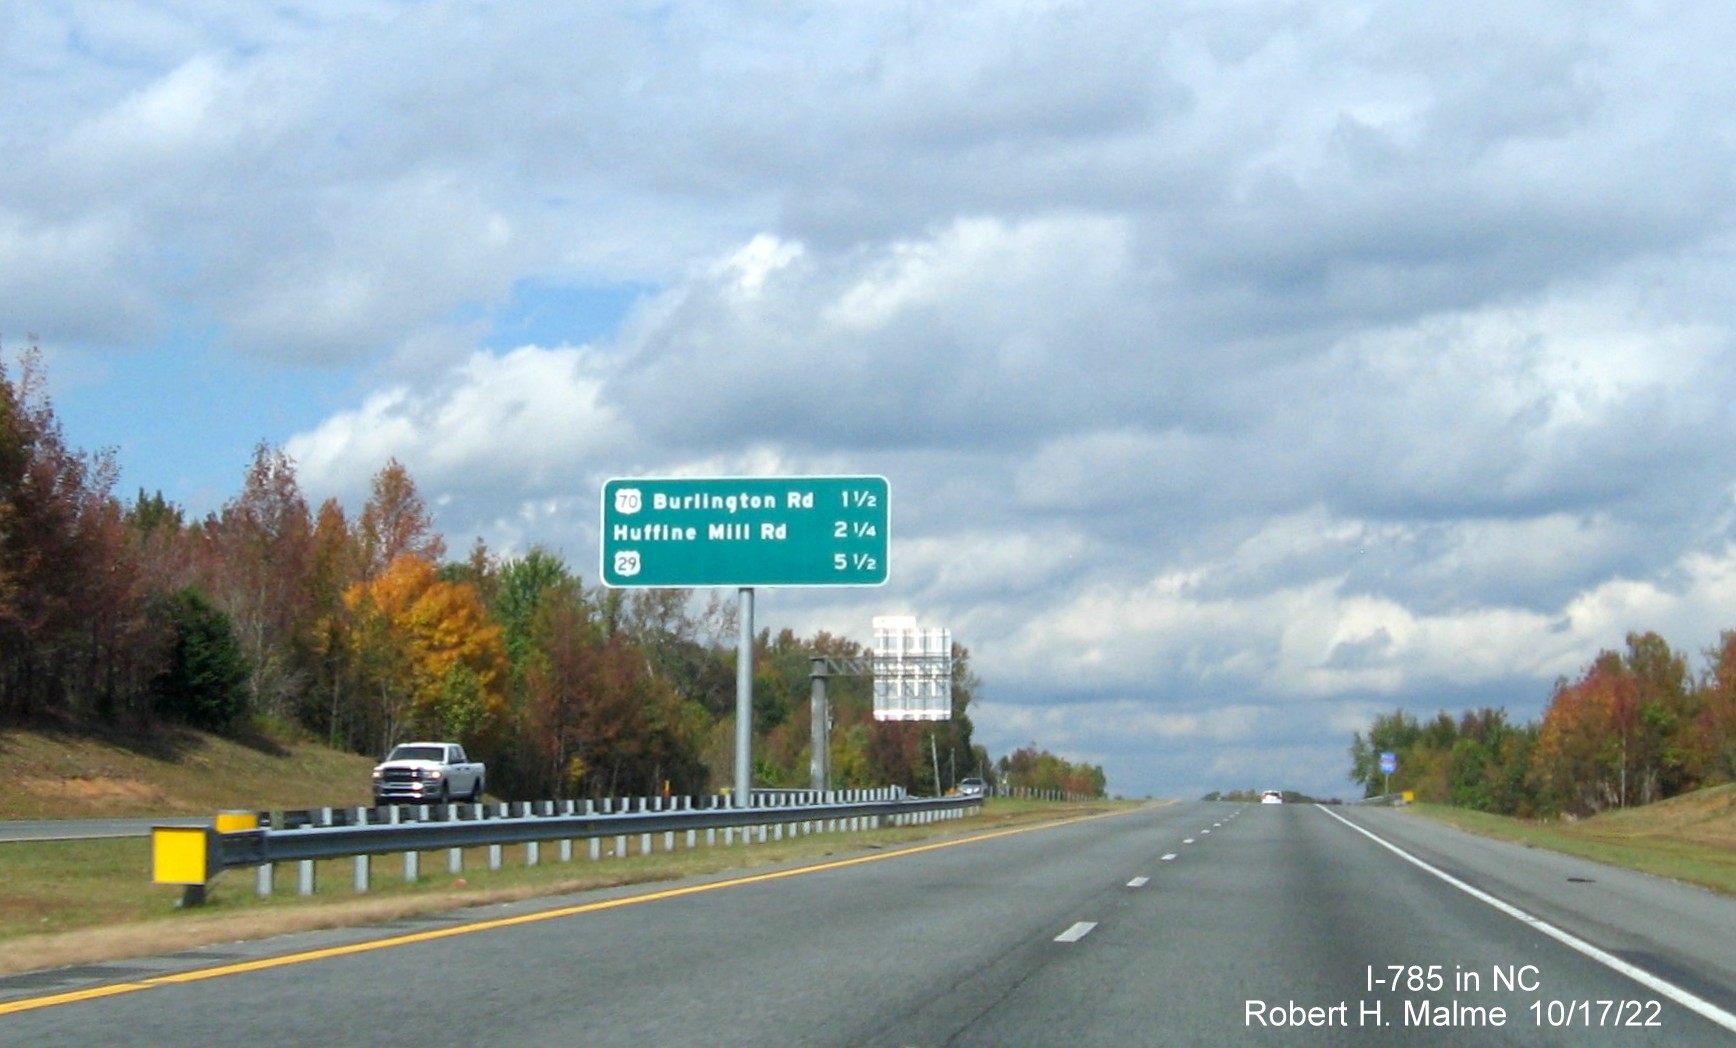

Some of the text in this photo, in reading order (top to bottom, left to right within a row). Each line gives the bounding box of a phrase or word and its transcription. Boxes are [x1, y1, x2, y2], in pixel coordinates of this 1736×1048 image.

[619, 494, 638, 509] 70
[654, 492, 813, 513] Burlington Rd
[842, 491, 848, 506] 1
[614, 523, 786, 540] Huffine Mill Rd
[835, 521, 847, 537] 2
[618, 557, 637, 571] 29
[835, 554, 846, 569] 5
